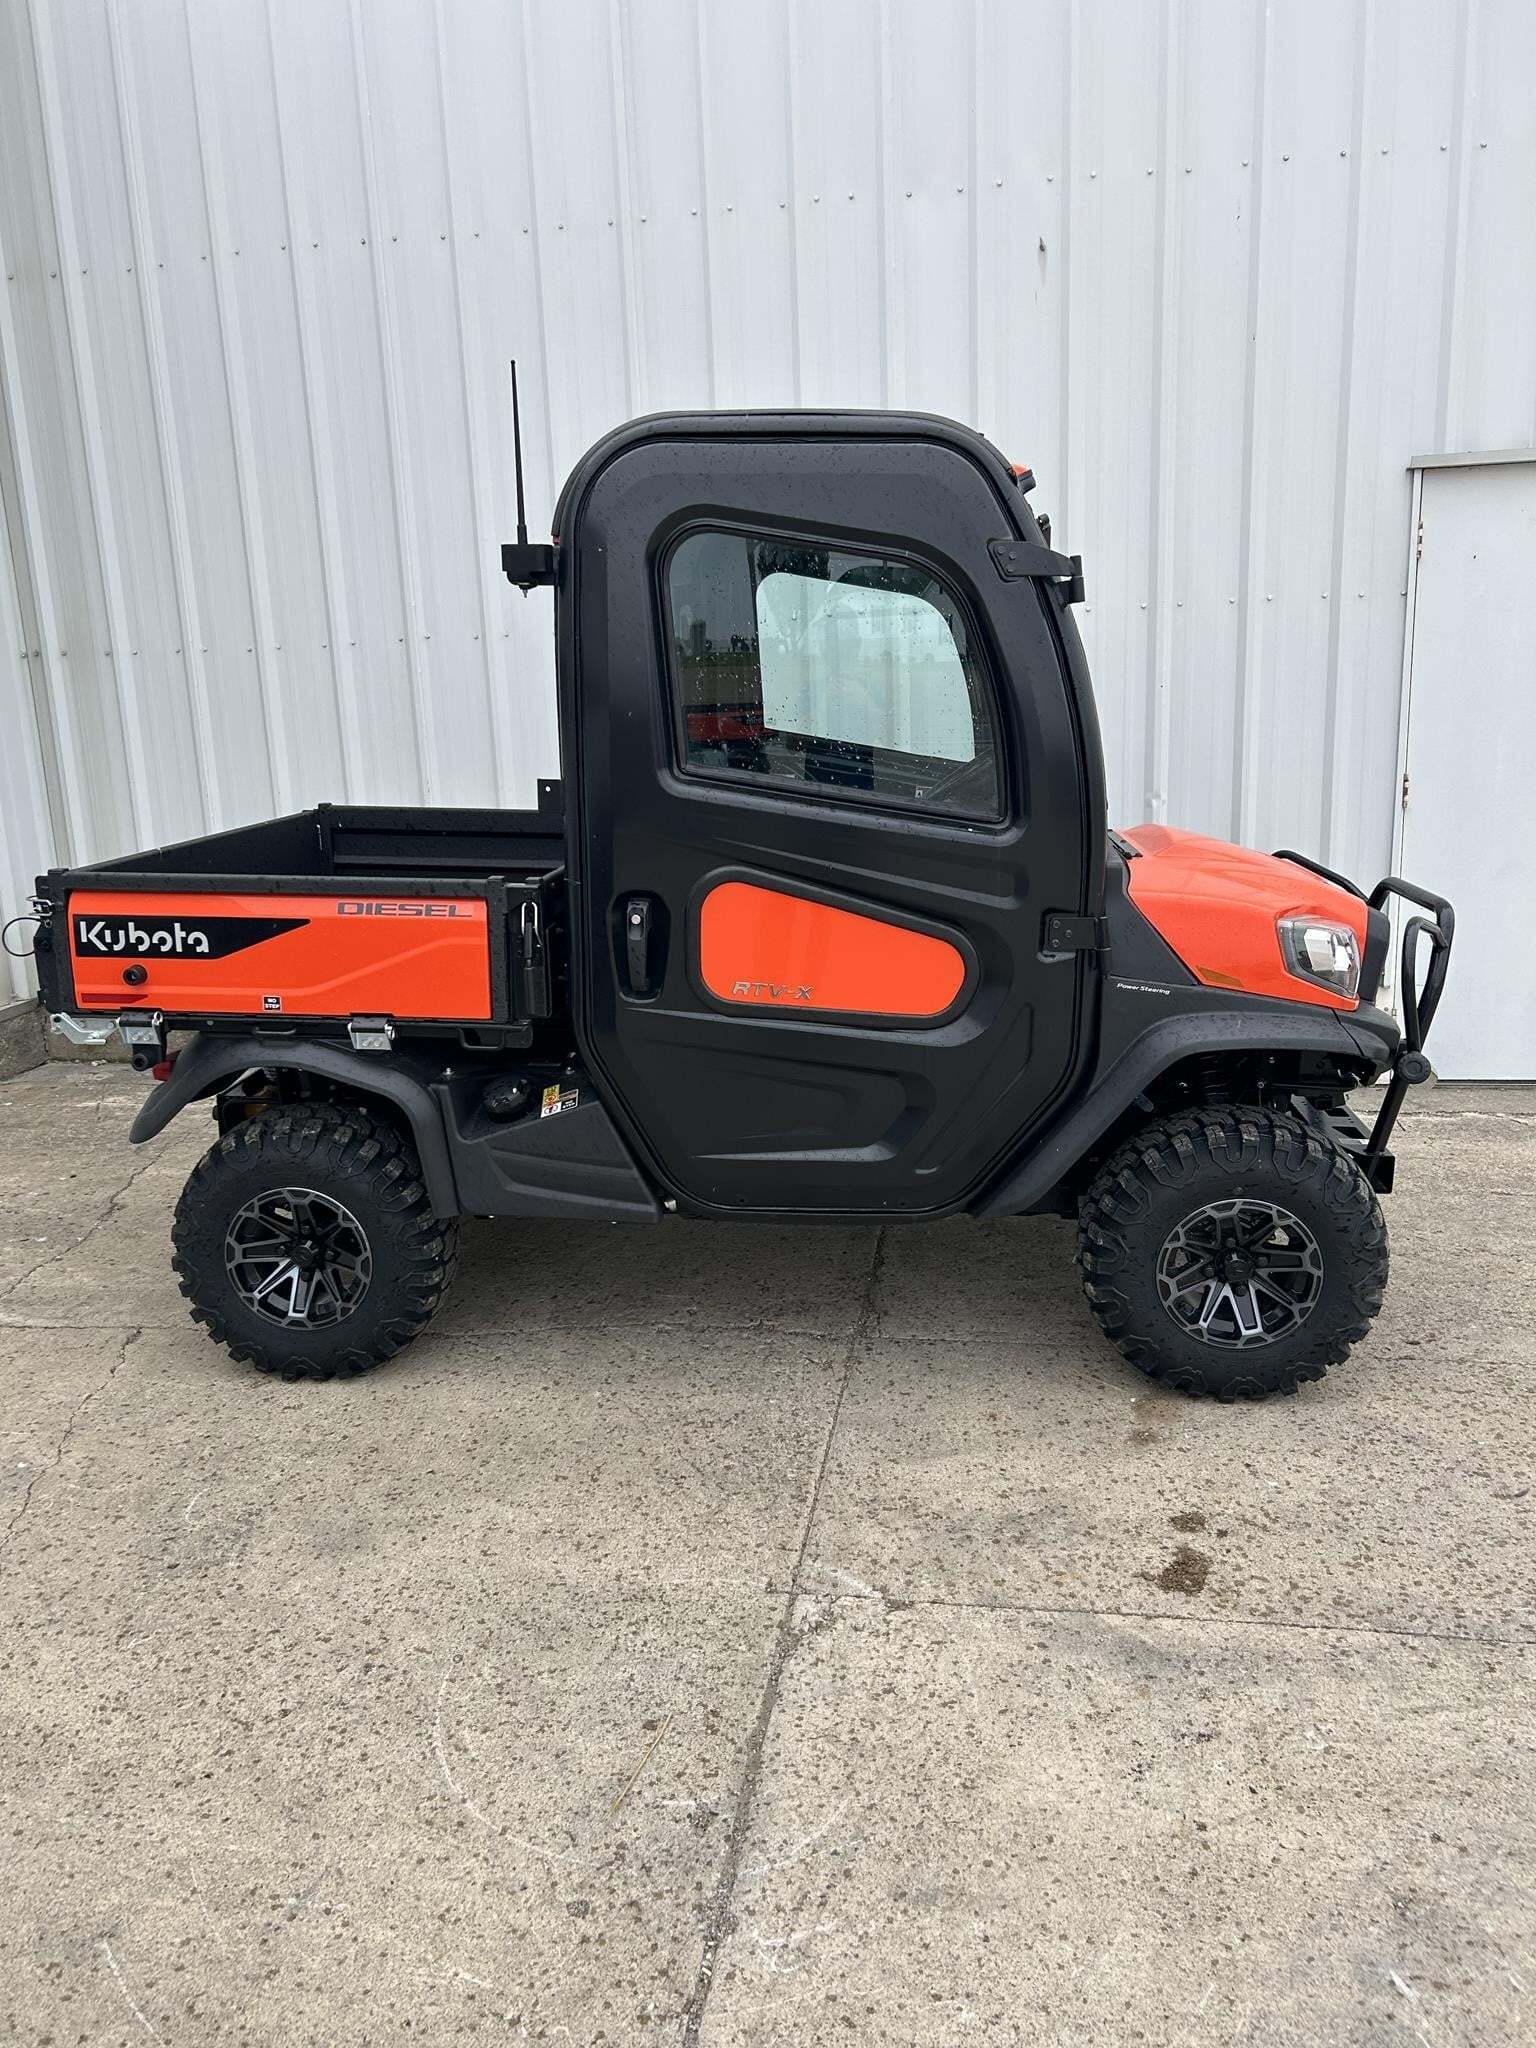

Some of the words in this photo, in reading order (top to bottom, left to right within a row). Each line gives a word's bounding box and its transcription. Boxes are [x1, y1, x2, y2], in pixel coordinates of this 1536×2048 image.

[337, 902, 472, 918] DIESEL
[80, 921, 210, 953] Kubota
[732, 981, 813, 999] RTV-X
[1140, 986, 1171, 995] Steering
